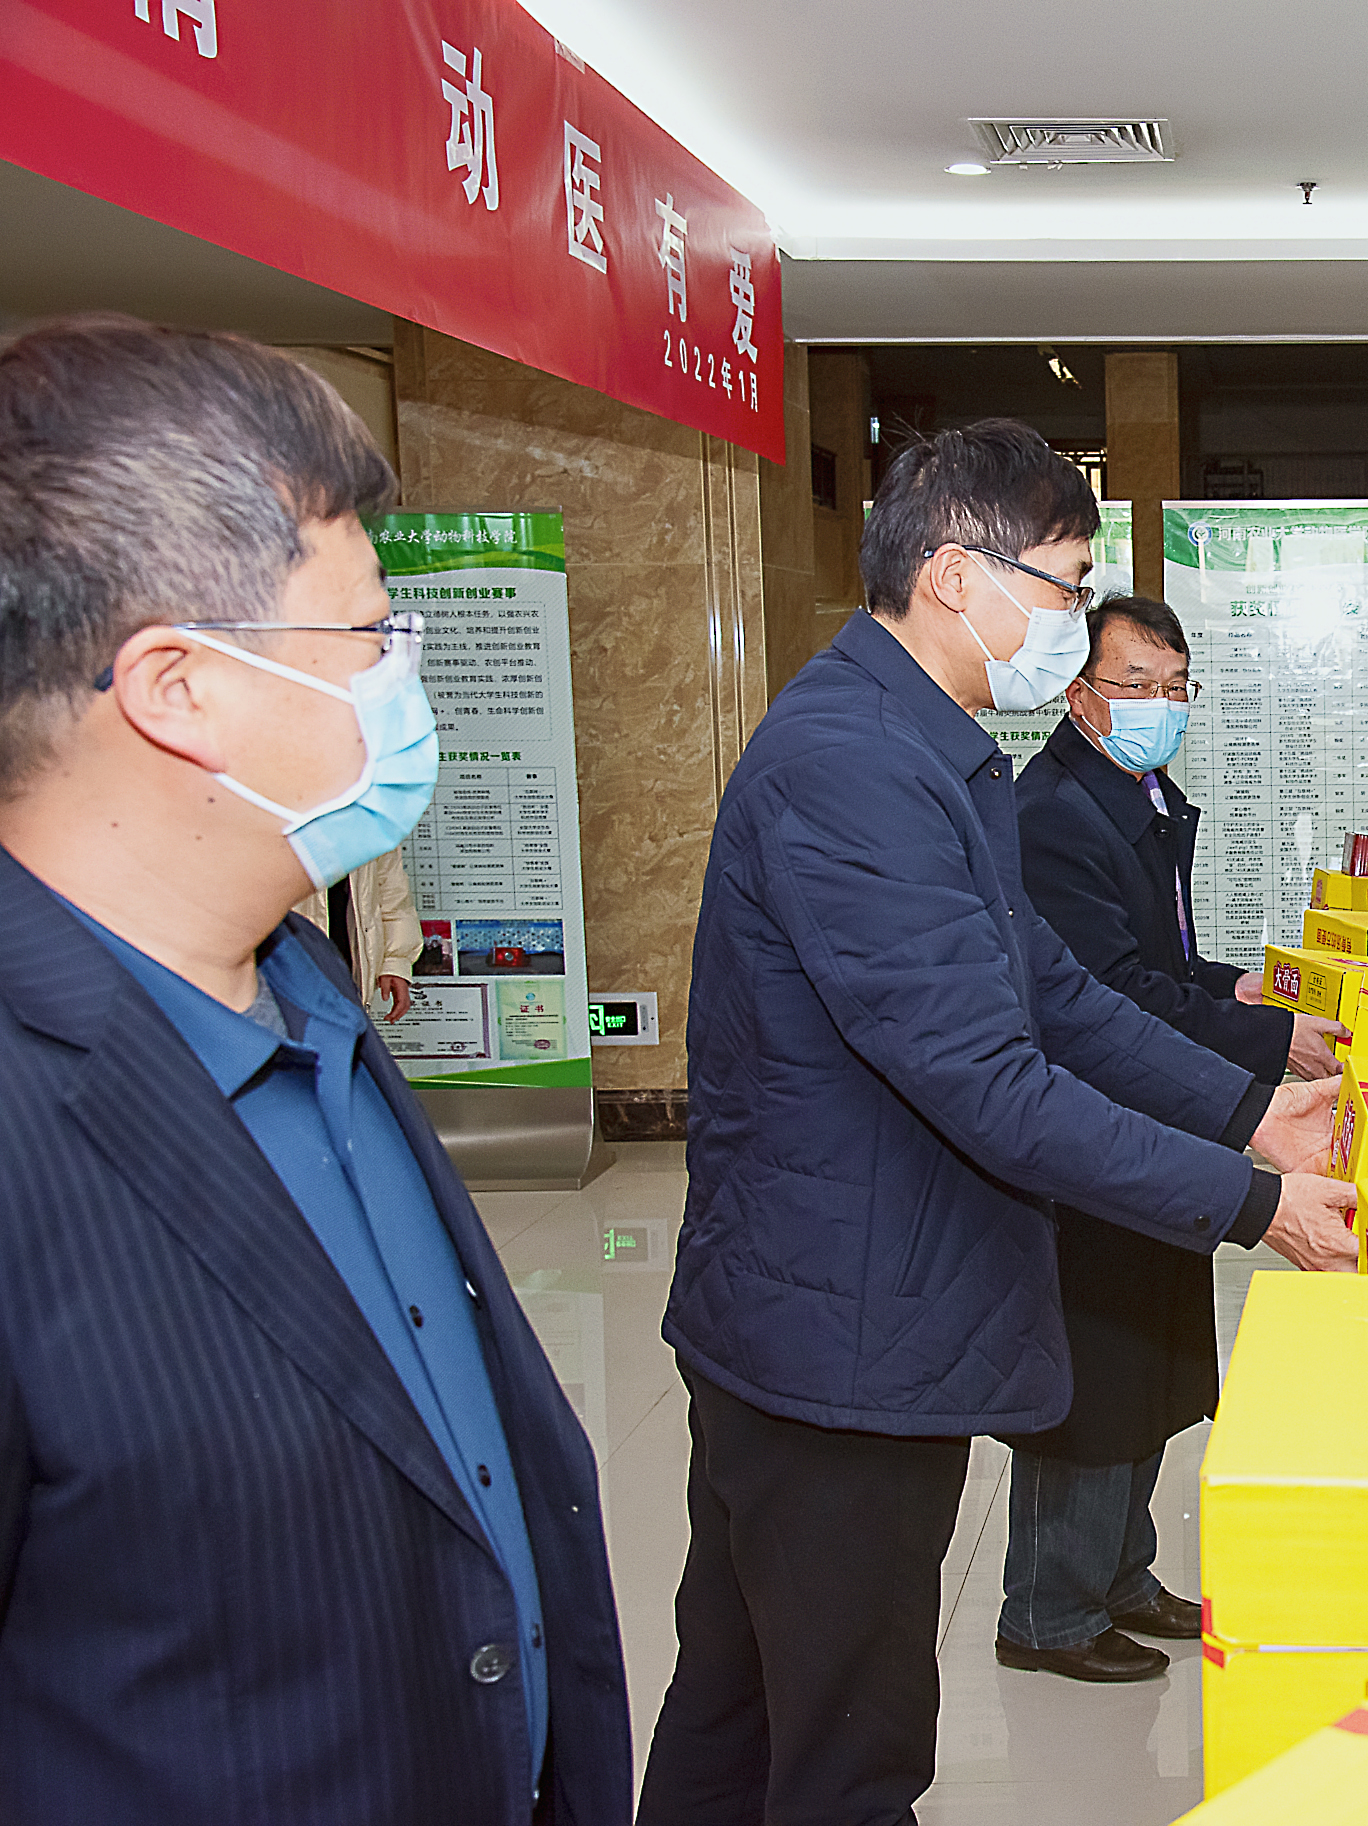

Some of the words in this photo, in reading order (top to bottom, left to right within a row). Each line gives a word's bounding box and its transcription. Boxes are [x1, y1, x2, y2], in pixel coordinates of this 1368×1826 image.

[662, 330, 760, 414] 2022年1月
[1274, 964, 1299, 996] 大骨面
